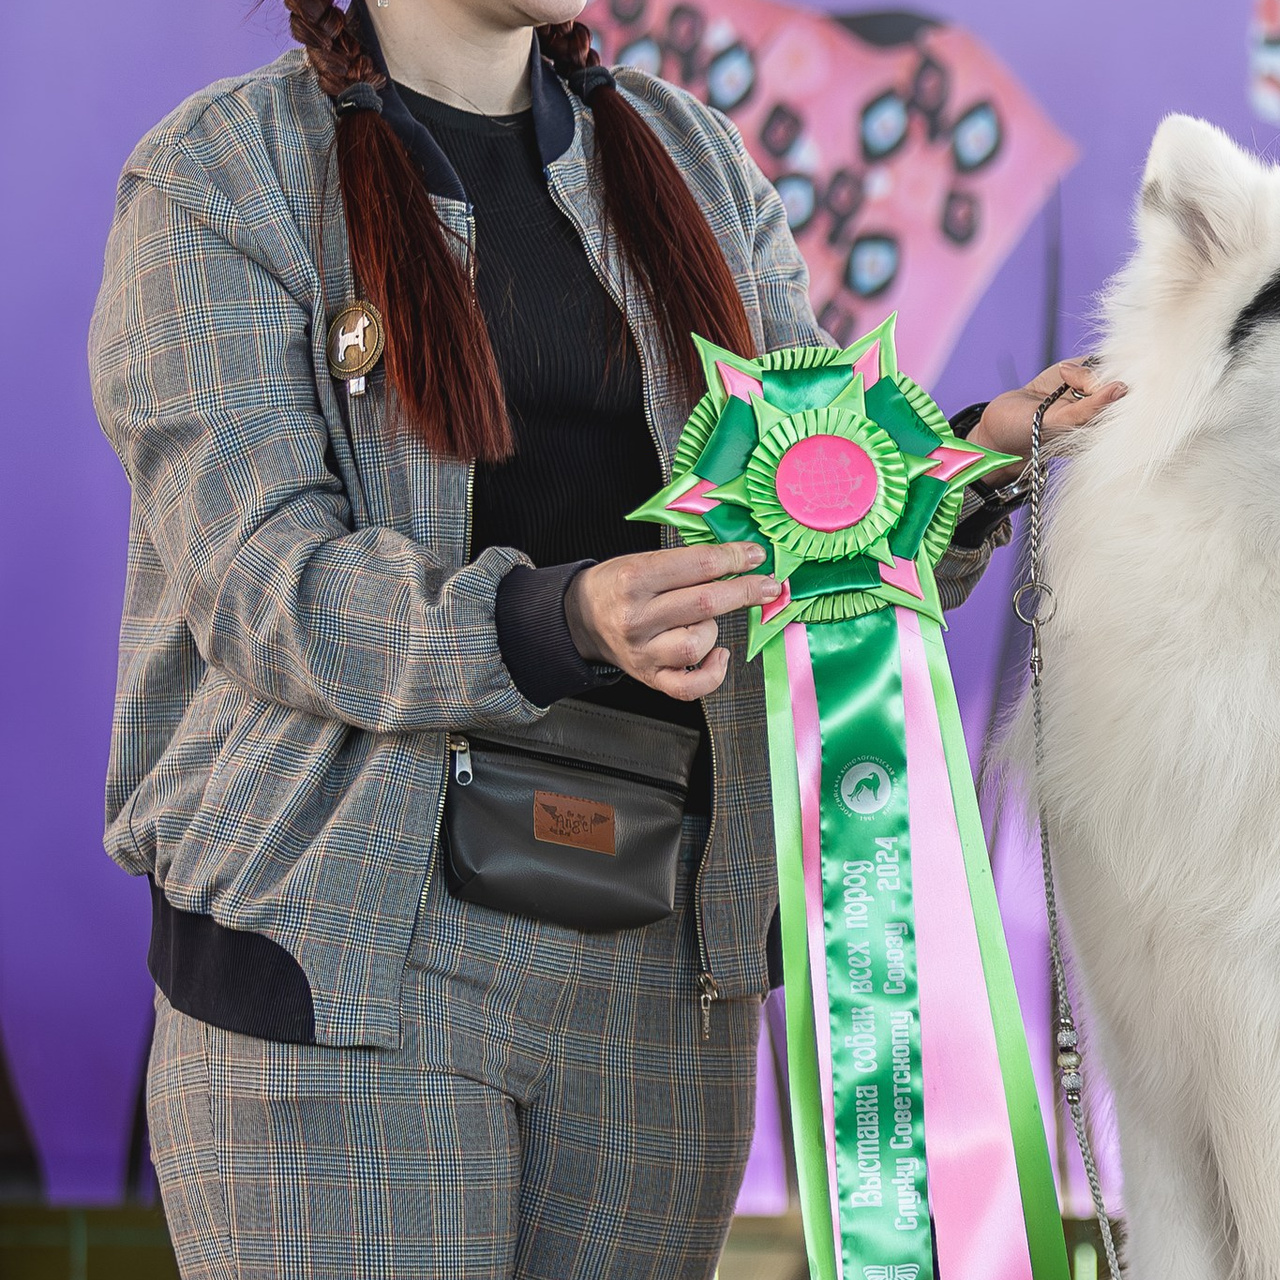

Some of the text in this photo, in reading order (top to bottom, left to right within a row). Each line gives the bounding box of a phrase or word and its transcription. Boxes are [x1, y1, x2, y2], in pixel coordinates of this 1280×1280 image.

[874, 836, 901, 892] 2024
[883, 922, 908, 994] Союзу
[842, 860, 882, 1207] Выставка собак всех пород
[890, 1010, 914, 1149] Советскому
[891, 1156, 922, 1231] Служу
